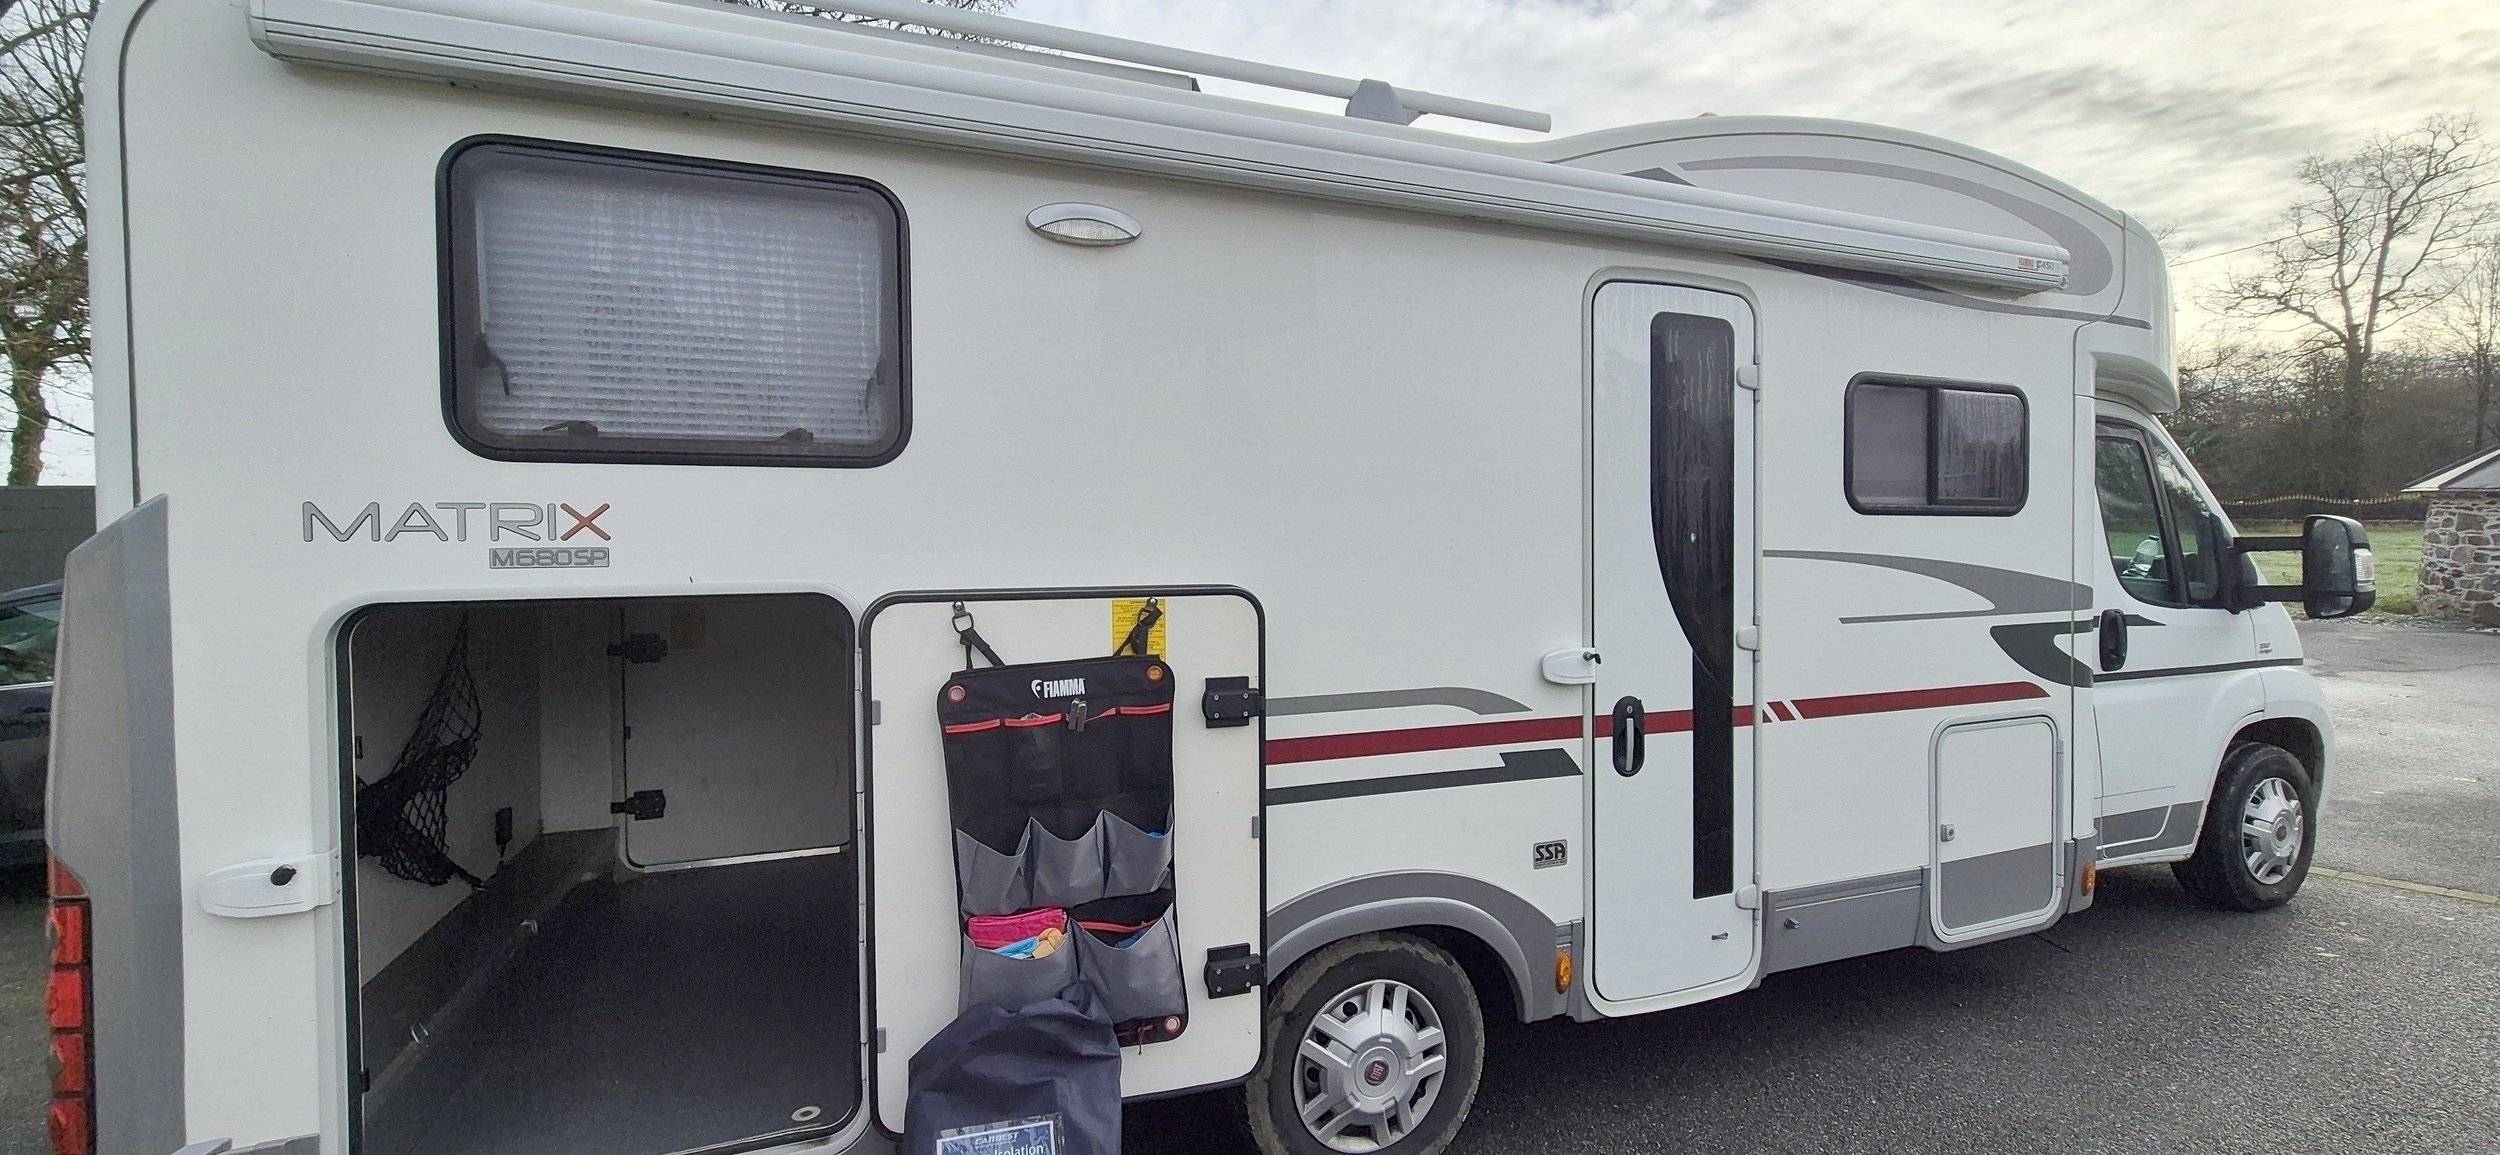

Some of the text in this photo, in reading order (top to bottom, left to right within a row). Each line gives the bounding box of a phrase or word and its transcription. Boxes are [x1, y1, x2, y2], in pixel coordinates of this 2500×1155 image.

[302, 501, 611, 542] MATRIX
[492, 549, 607, 566] M680SP
[1043, 678, 1085, 698] FIAMMA
